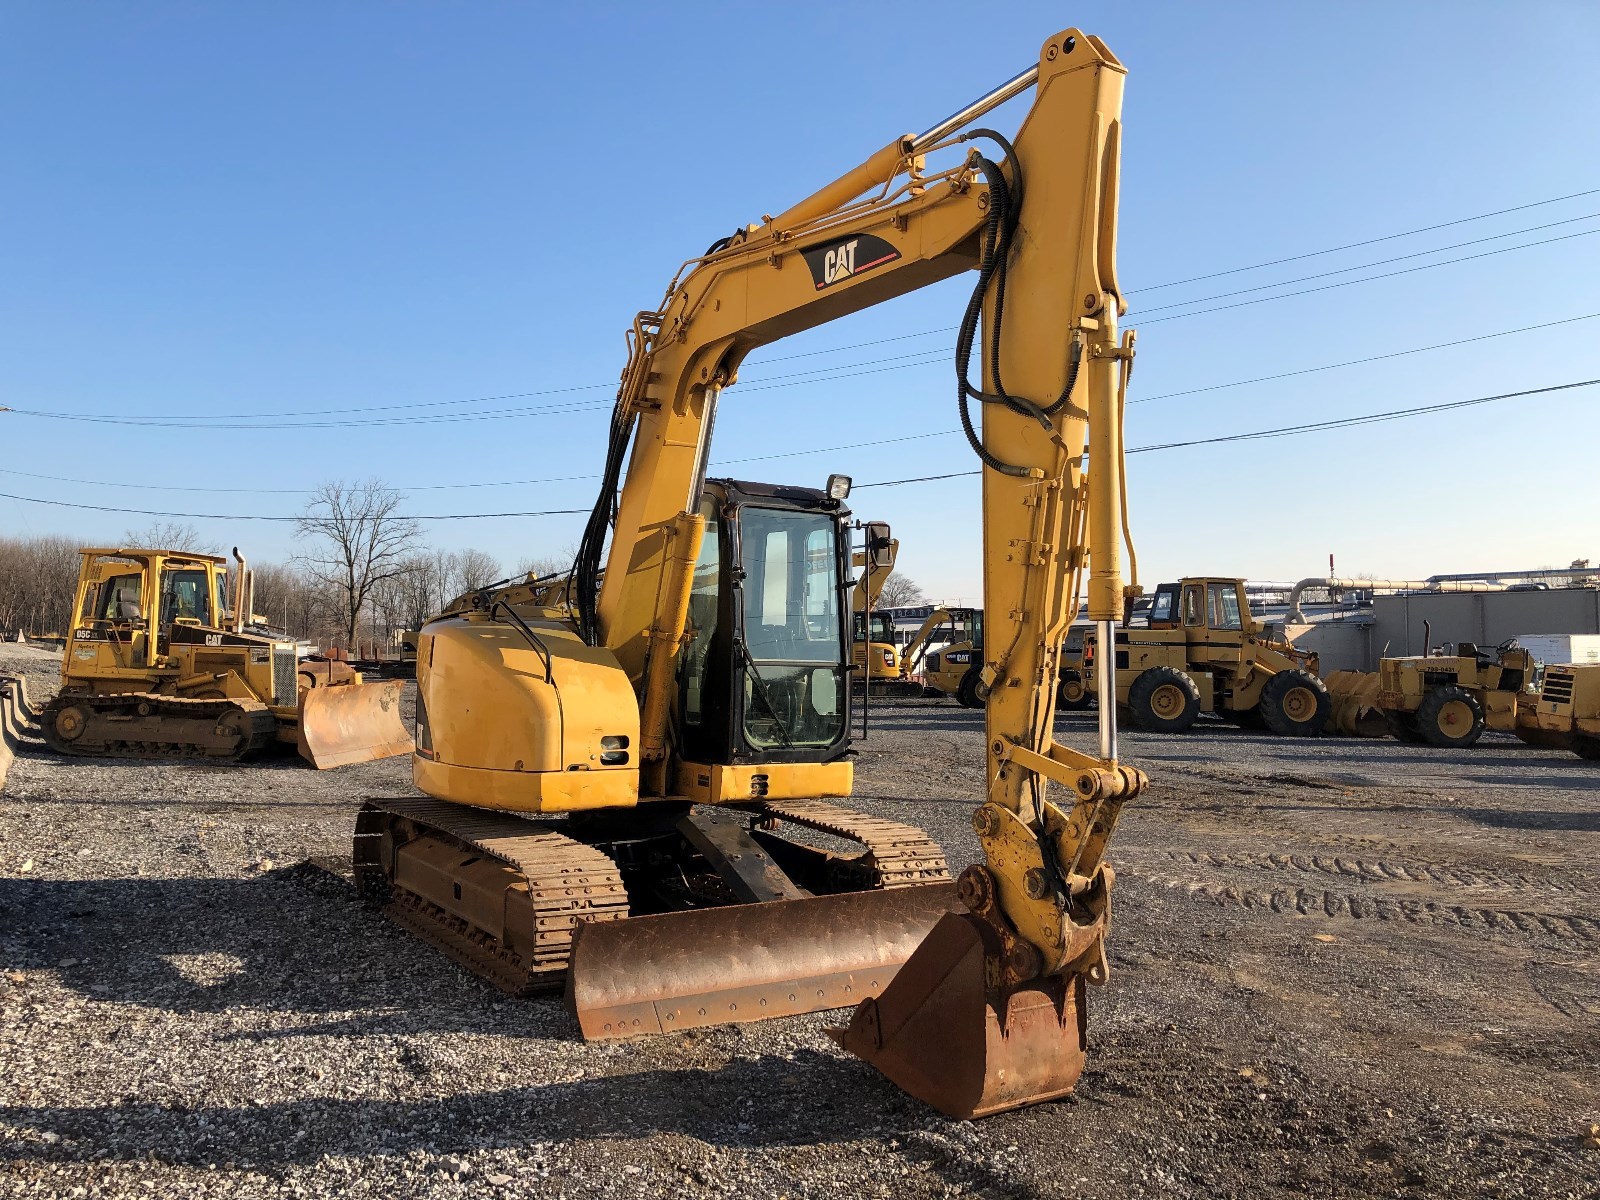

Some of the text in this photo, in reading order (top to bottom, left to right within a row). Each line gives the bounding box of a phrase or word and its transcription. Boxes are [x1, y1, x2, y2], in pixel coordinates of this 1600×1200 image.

[824, 239, 859, 284] CAT
[205, 634, 223, 647] CAT
[956, 654, 970, 663] CAT
